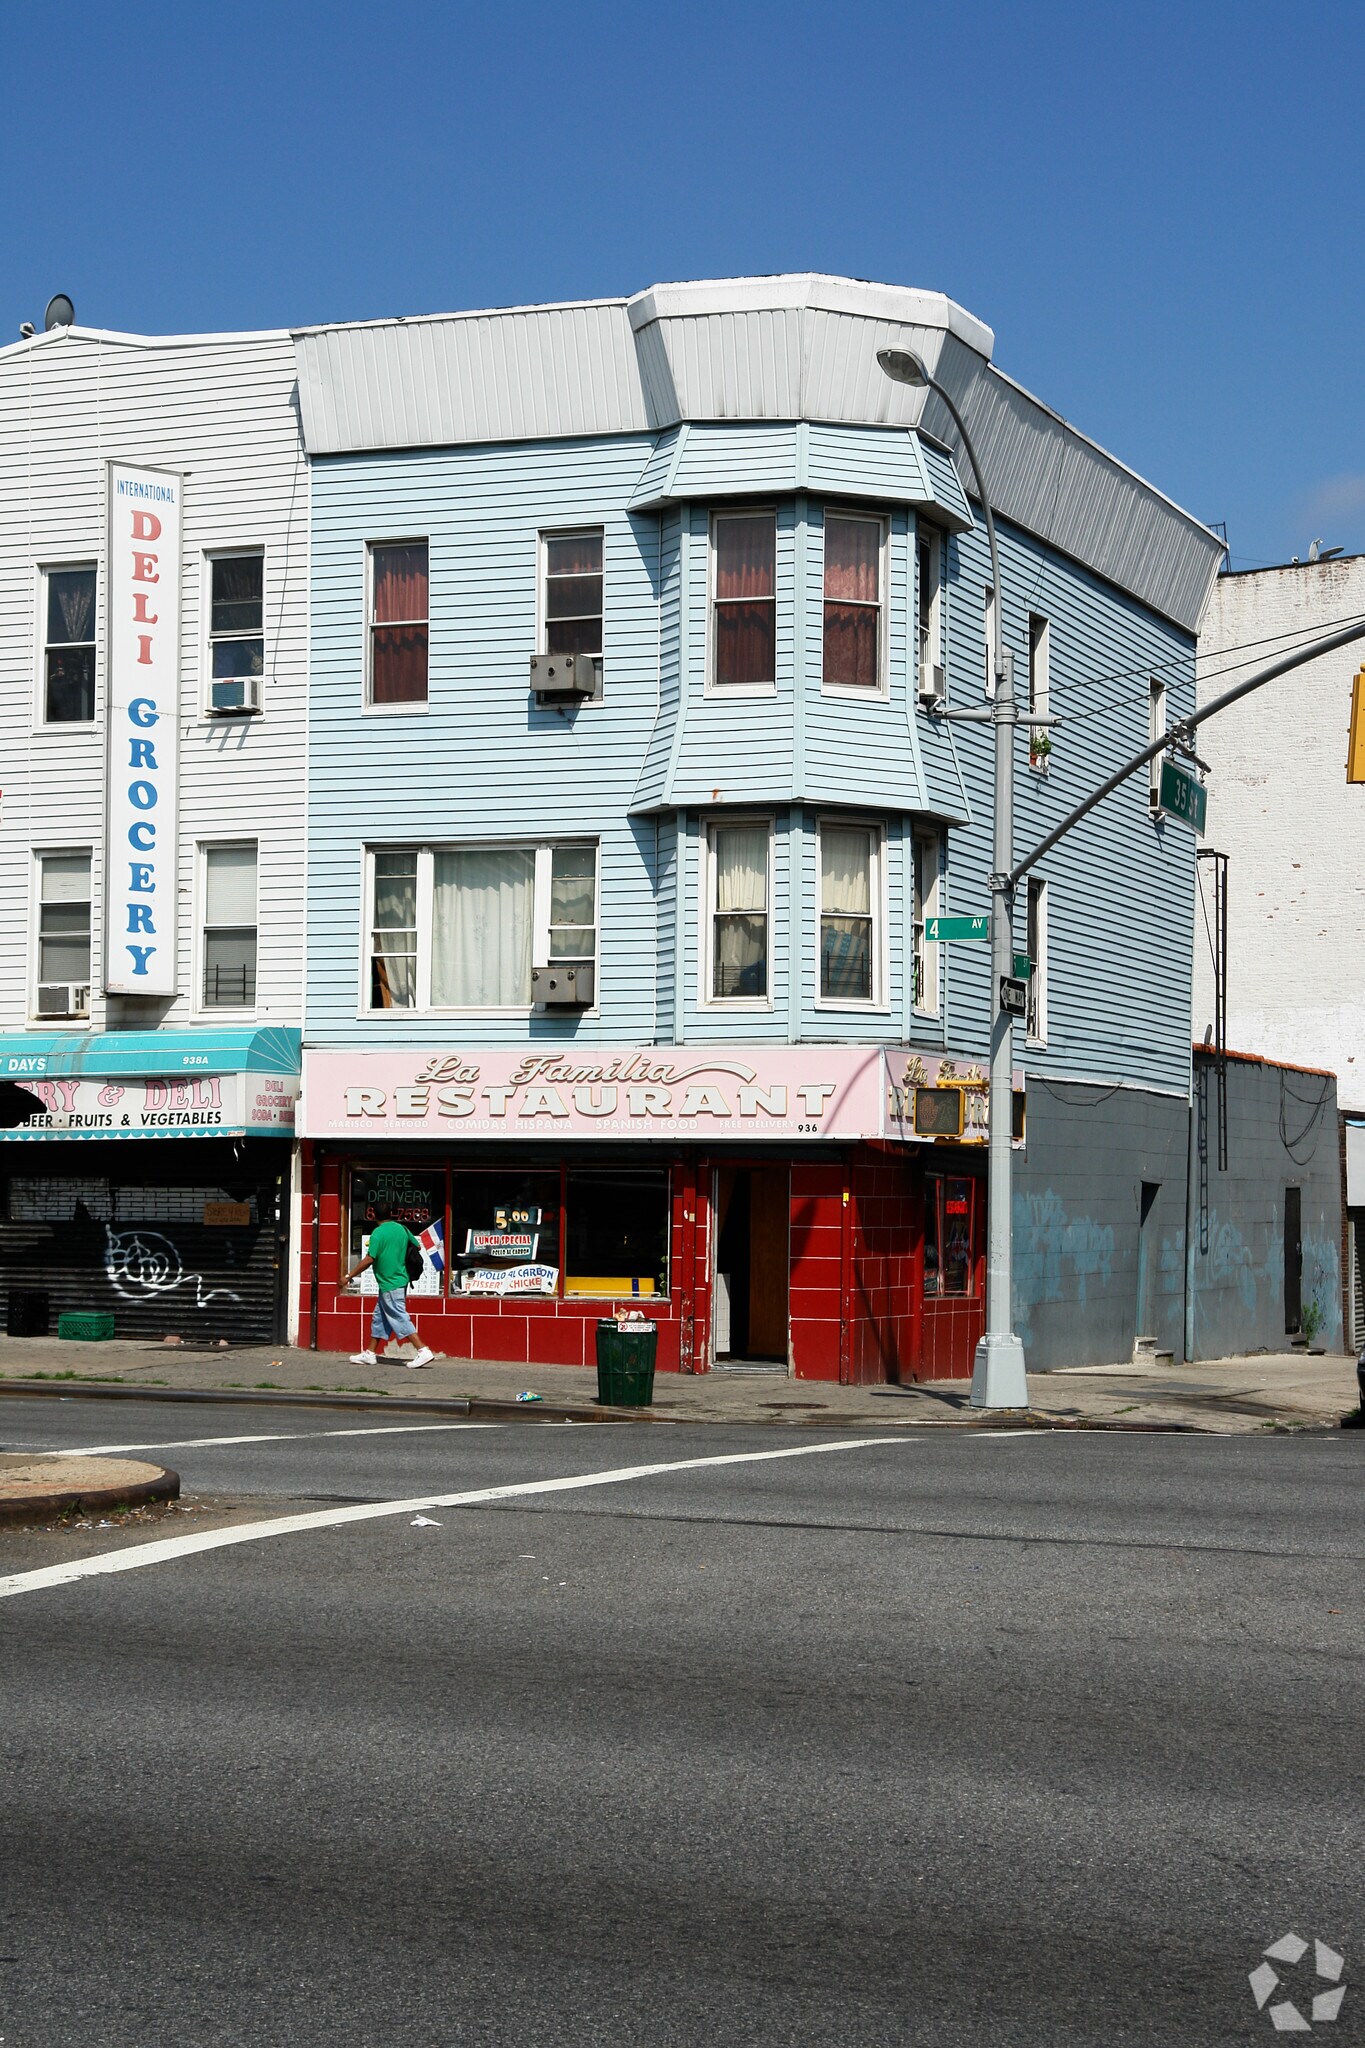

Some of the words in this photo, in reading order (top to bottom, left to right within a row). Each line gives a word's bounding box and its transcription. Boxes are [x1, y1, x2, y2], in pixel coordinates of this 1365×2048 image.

[116, 479, 175, 504] INTERNATIONAL
[130, 509, 162, 665] DELI
[1174, 778, 1187, 811] 35
[1188, 788, 1199, 820] St
[126, 697, 161, 976] GROCERY
[929, 919, 940, 939] 4
[971, 918, 984, 929] AV
[8, 1057, 47, 1072] DAYS
[182, 1056, 209, 1065] 938A
[415, 1054, 480, 1084] La
[510, 1053, 757, 1086] Familia
[97, 1085, 126, 1108] &
[143, 1076, 222, 1111] DELI
[264, 1079, 284, 1093] DELI
[255, 1094, 293, 1108] GROCERY
[344, 1083, 837, 1118] RESTAURANT
[68, 1113, 113, 1127] FRUITS
[120, 1113, 131, 1127] &
[140, 1111, 222, 1126] VEGETABLES
[251, 1108, 273, 1122] SODA
[328, 1120, 374, 1129] MARISCO
[384, 1120, 429, 1129] SEAFOOD
[447, 1119, 508, 1130] COMIDAS
[515, 1119, 574, 1130] HISPANA
[595, 1119, 654, 1130] SPANISH
[660, 1119, 698, 1130] FOOD
[719, 1119, 742, 1129] FREE
[747, 1119, 797, 1129] DELIVERY
[797, 1123, 818, 1133] 936
[376, 1173, 413, 1188] FREE
[495, 1210, 529, 1230] 5.00
[474, 1235, 500, 1246] LUNCH
[501, 1234, 533, 1246] SPECIAL
[479, 1270, 507, 1281] POLLO
